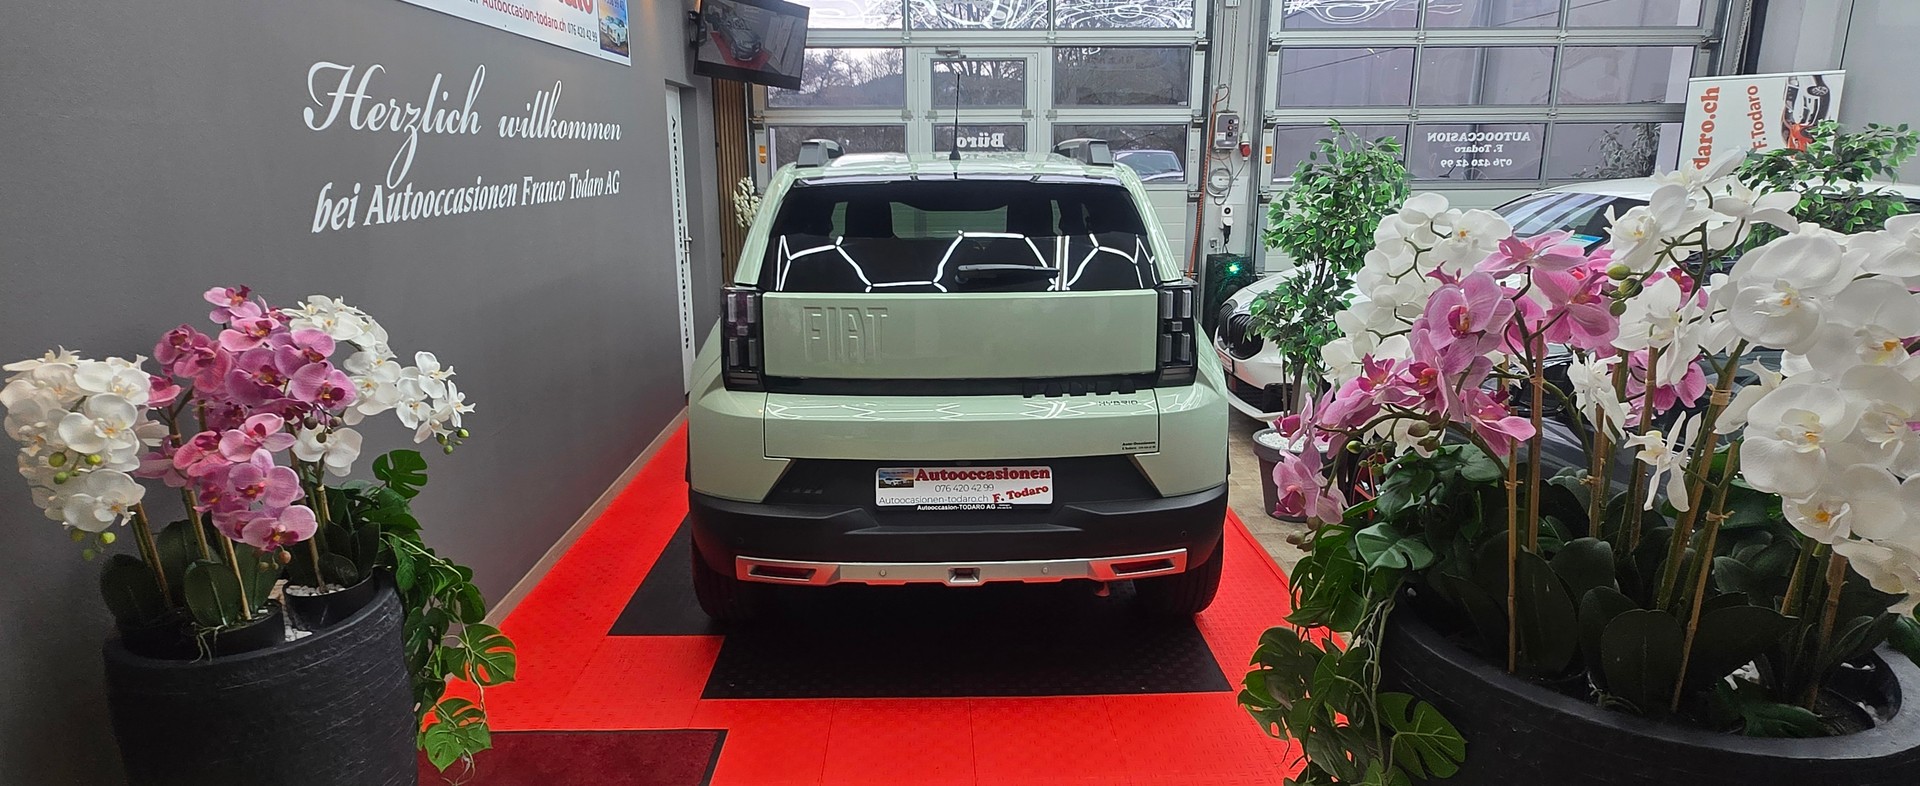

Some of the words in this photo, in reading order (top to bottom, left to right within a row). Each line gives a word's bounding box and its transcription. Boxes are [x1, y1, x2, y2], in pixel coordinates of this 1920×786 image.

[567, 22, 577, 36] 076
[577, 26, 586, 39] 420
[303, 61, 486, 189] Herzlich
[498, 80, 622, 142] willkommen
[311, 182, 360, 233] bei
[363, 175, 517, 226] Autooccasionen
[521, 176, 566, 206] Franco
[569, 171, 603, 200] Todaro
[605, 169, 620, 195] AG
[802, 305, 888, 364] FIAT
[915, 467, 1051, 482] Autooccasionen
[935, 484, 952, 493] 076
[953, 484, 969, 493] 420
[971, 484, 982, 492] 42
[983, 484, 995, 492] 99
[992, 493, 1005, 503] F.
[1006, 485, 1049, 501] Todaro
[879, 495, 989, 505] Autoocasionen-todaro.ch
